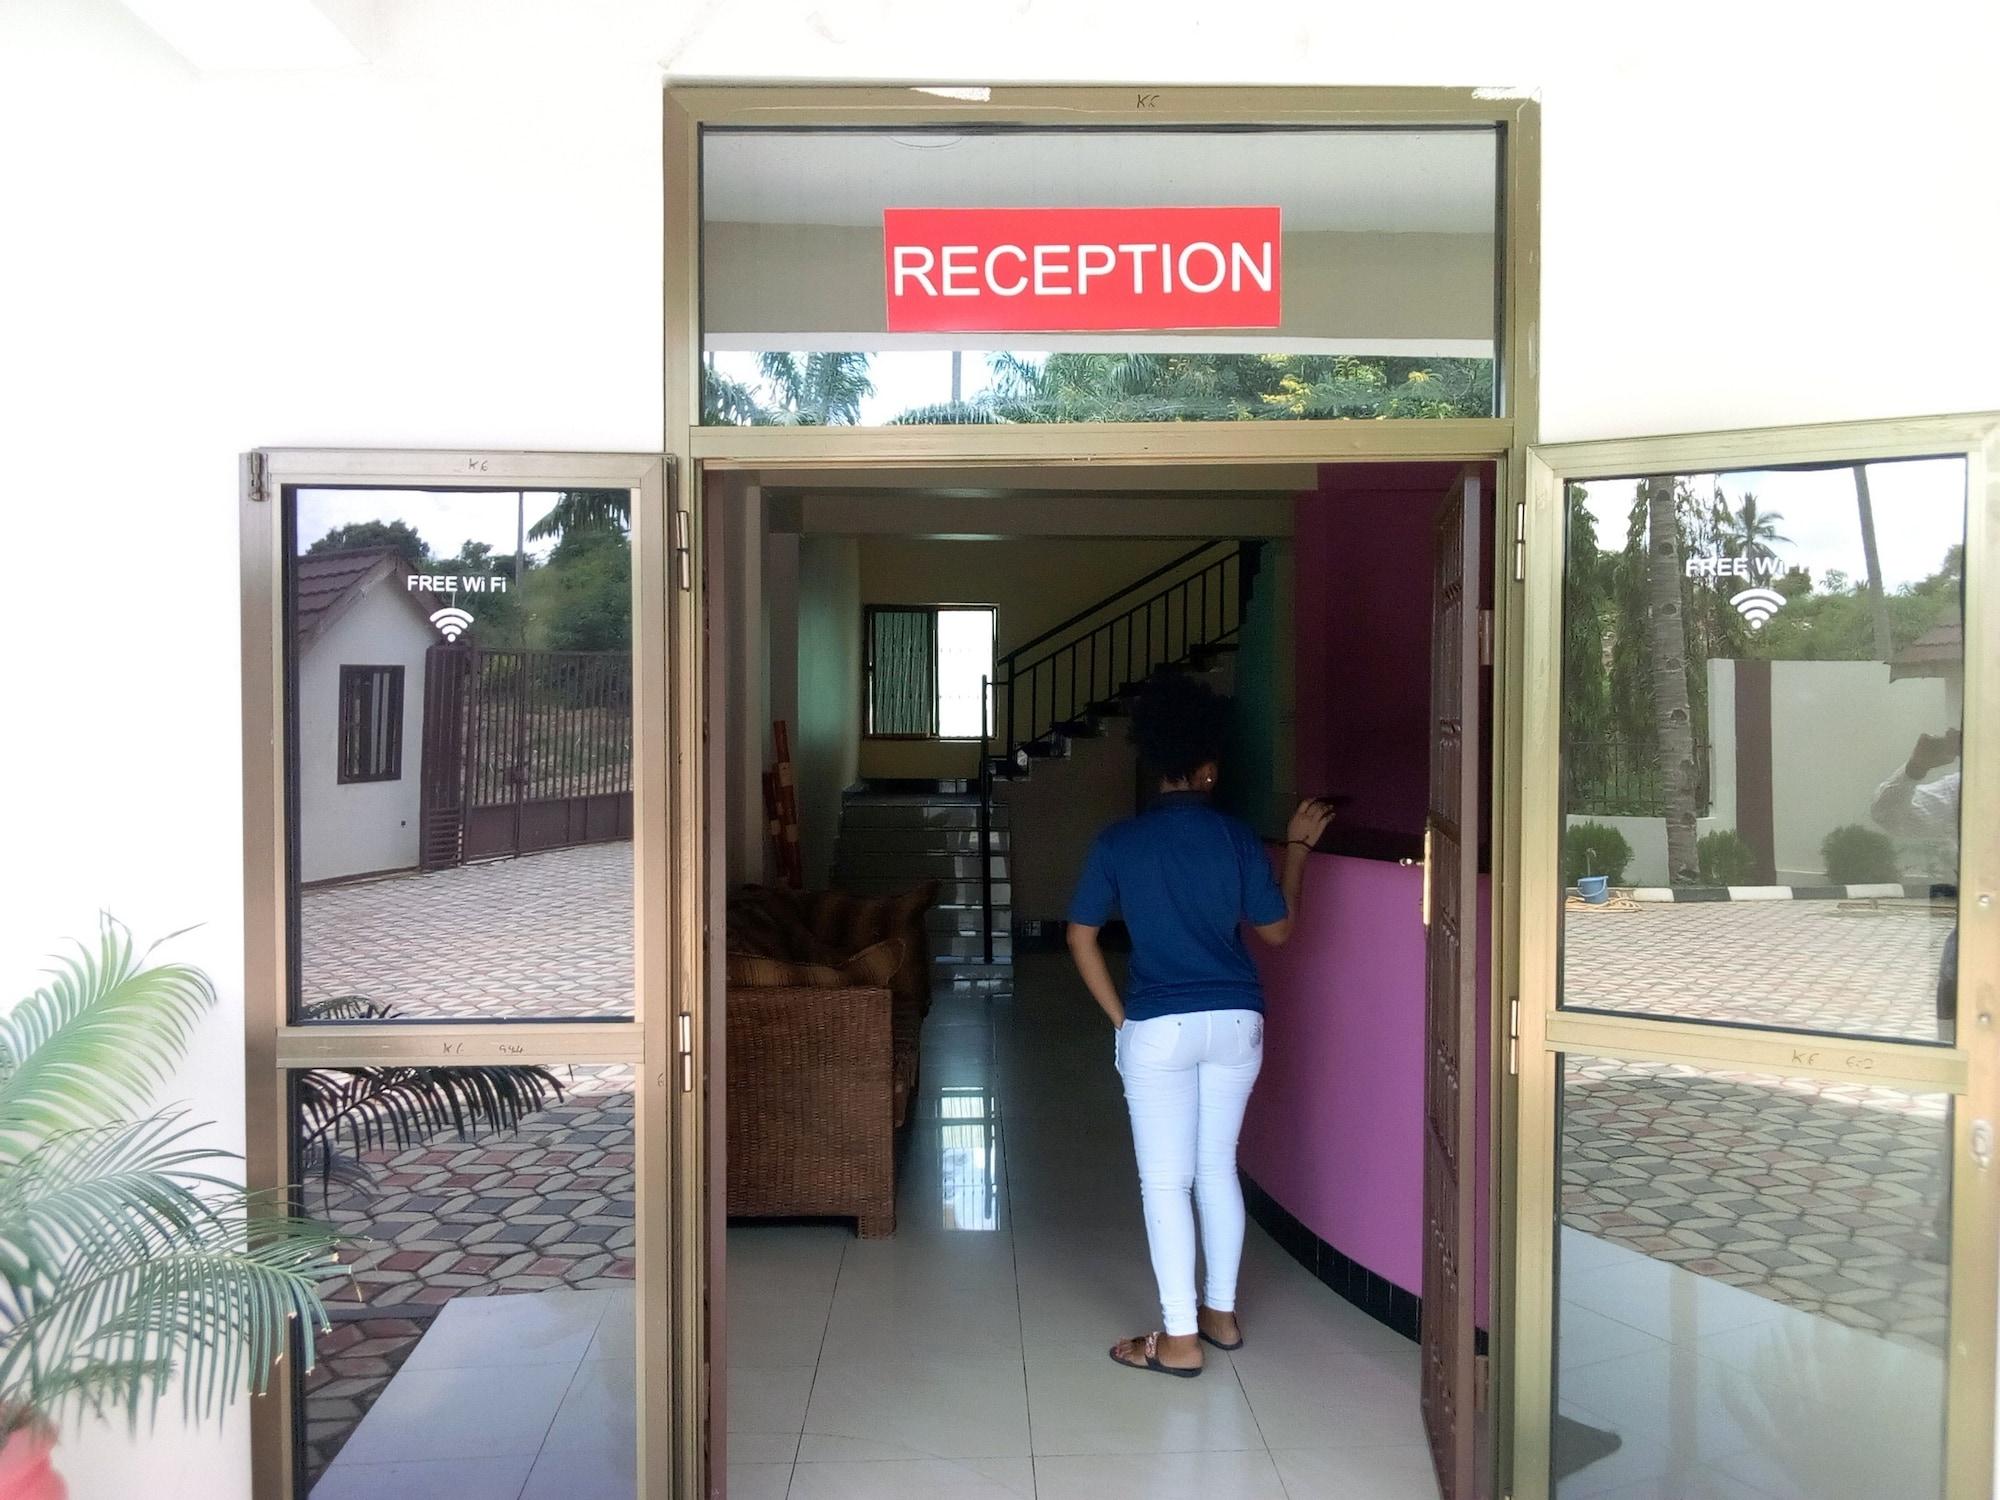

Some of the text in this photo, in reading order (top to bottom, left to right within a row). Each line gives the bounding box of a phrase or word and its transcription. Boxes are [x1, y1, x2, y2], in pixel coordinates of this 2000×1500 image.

[893, 241, 1273, 297] RECEPTION
[1685, 557, 1749, 577] FREE
[407, 575, 458, 592] FREE
